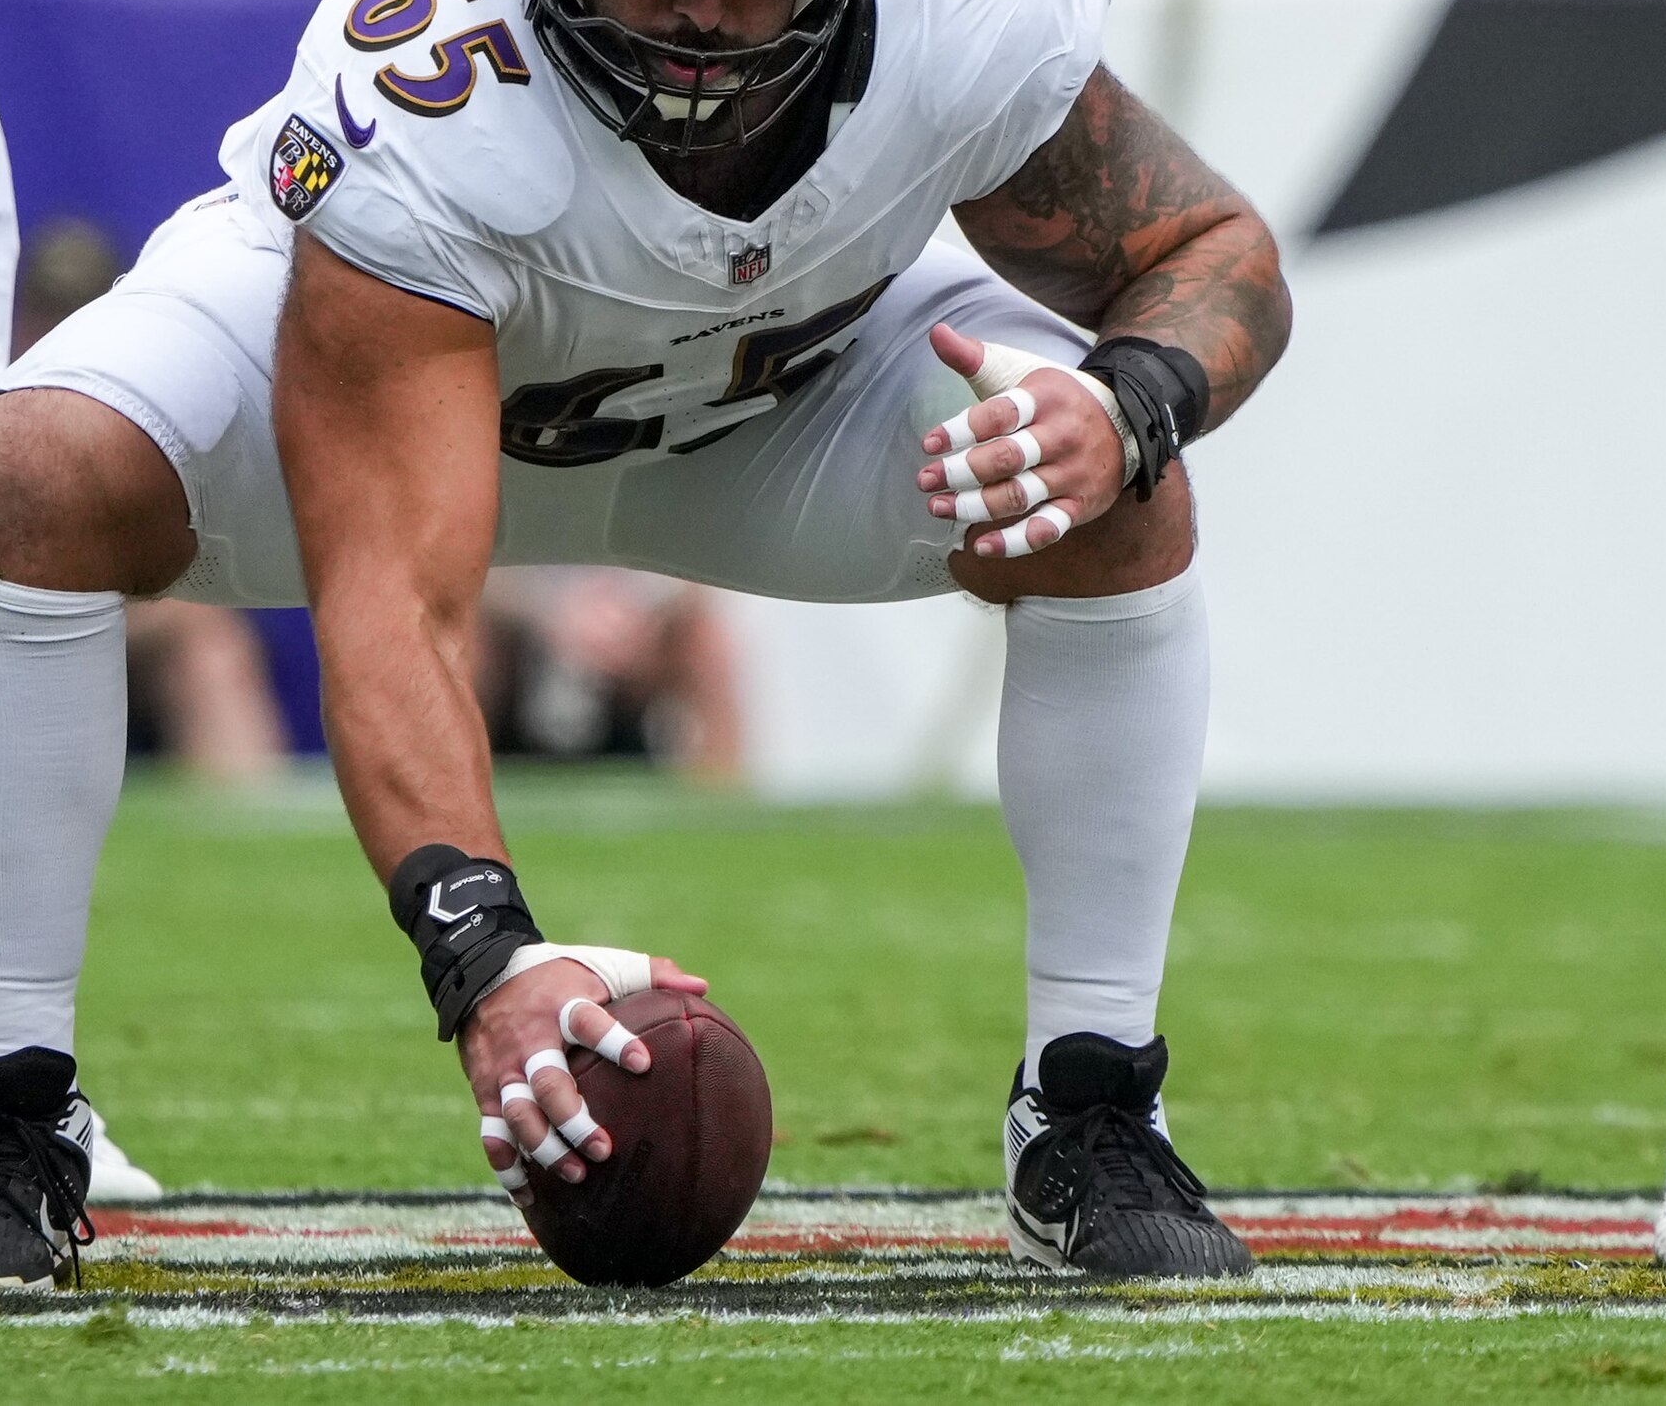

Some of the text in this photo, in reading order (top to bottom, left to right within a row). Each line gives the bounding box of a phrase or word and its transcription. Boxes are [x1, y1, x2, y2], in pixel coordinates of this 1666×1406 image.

[288, 117, 338, 169] RAVENS
[736, 258, 766, 282] NFL
[669, 308, 786, 346] RAVENS
